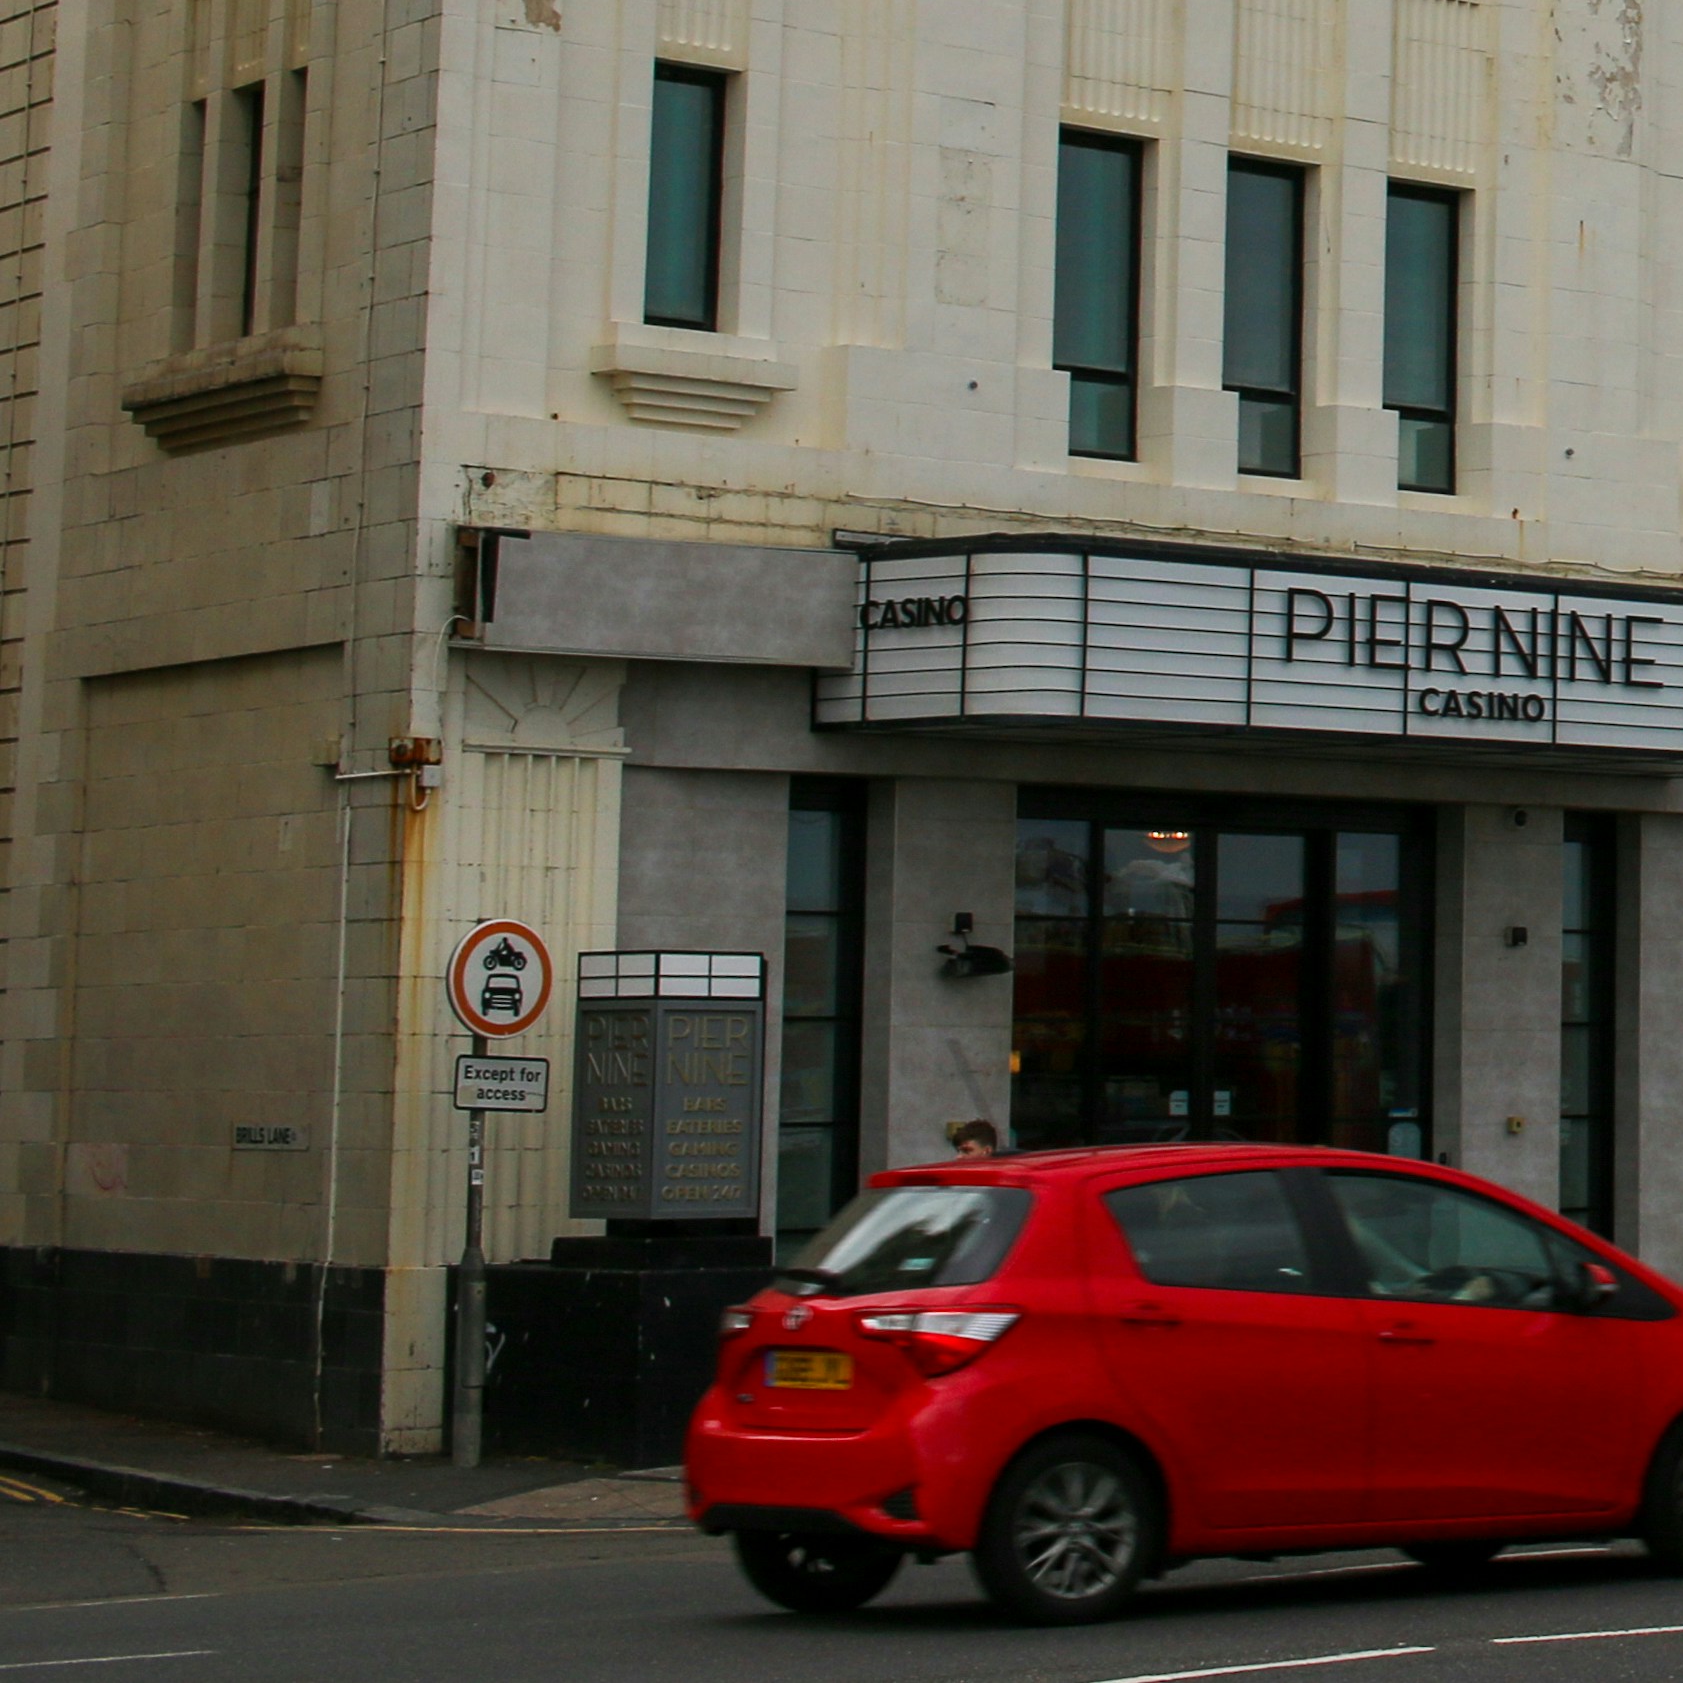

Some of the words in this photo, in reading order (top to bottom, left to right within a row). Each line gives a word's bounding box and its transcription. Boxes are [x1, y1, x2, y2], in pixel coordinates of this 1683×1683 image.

[860, 595, 969, 630] CASINO
[1286, 587, 1470, 676] PIER
[1493, 604, 1664, 688] NINE
[1419, 687, 1546, 723] CASINO
[667, 1015, 749, 1050] PIER
[464, 1065, 516, 1083] Except
[520, 1067, 541, 1082] for
[666, 1052, 748, 1086] NINE
[476, 1088, 526, 1101] access
[666, 1119, 743, 1134] EATERIES
[236, 1127, 264, 1144] BRILLS
[267, 1127, 291, 1145] LANE
[668, 1141, 740, 1156] GAMING
[665, 1162, 741, 1179] CASINOS
